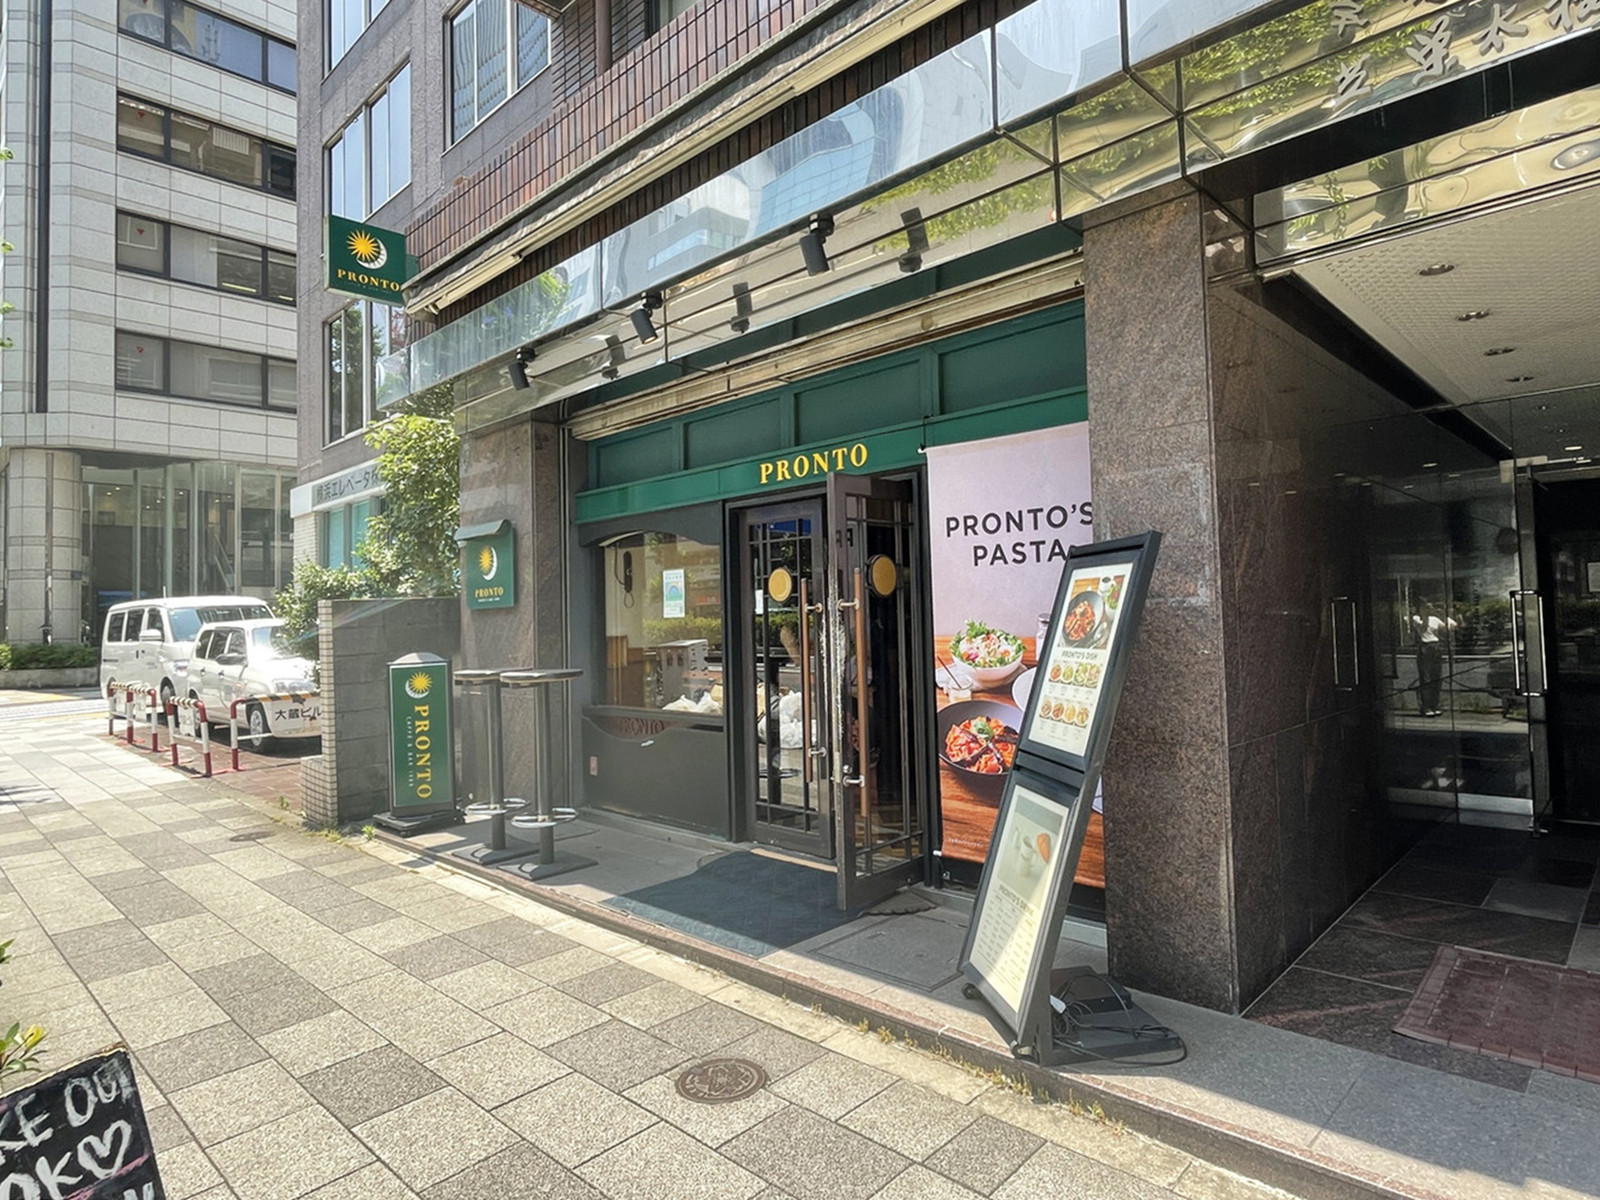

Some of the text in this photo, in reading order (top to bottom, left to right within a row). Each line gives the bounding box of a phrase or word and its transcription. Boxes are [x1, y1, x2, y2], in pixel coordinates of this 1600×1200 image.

[337, 268, 400, 292] PRONTO
[760, 443, 868, 485] PRONTO
[945, 501, 1093, 538] PRONTO'S
[973, 538, 1069, 567] PASTA
[474, 586, 504, 599] PRONTO
[414, 704, 433, 798] PRONTO
